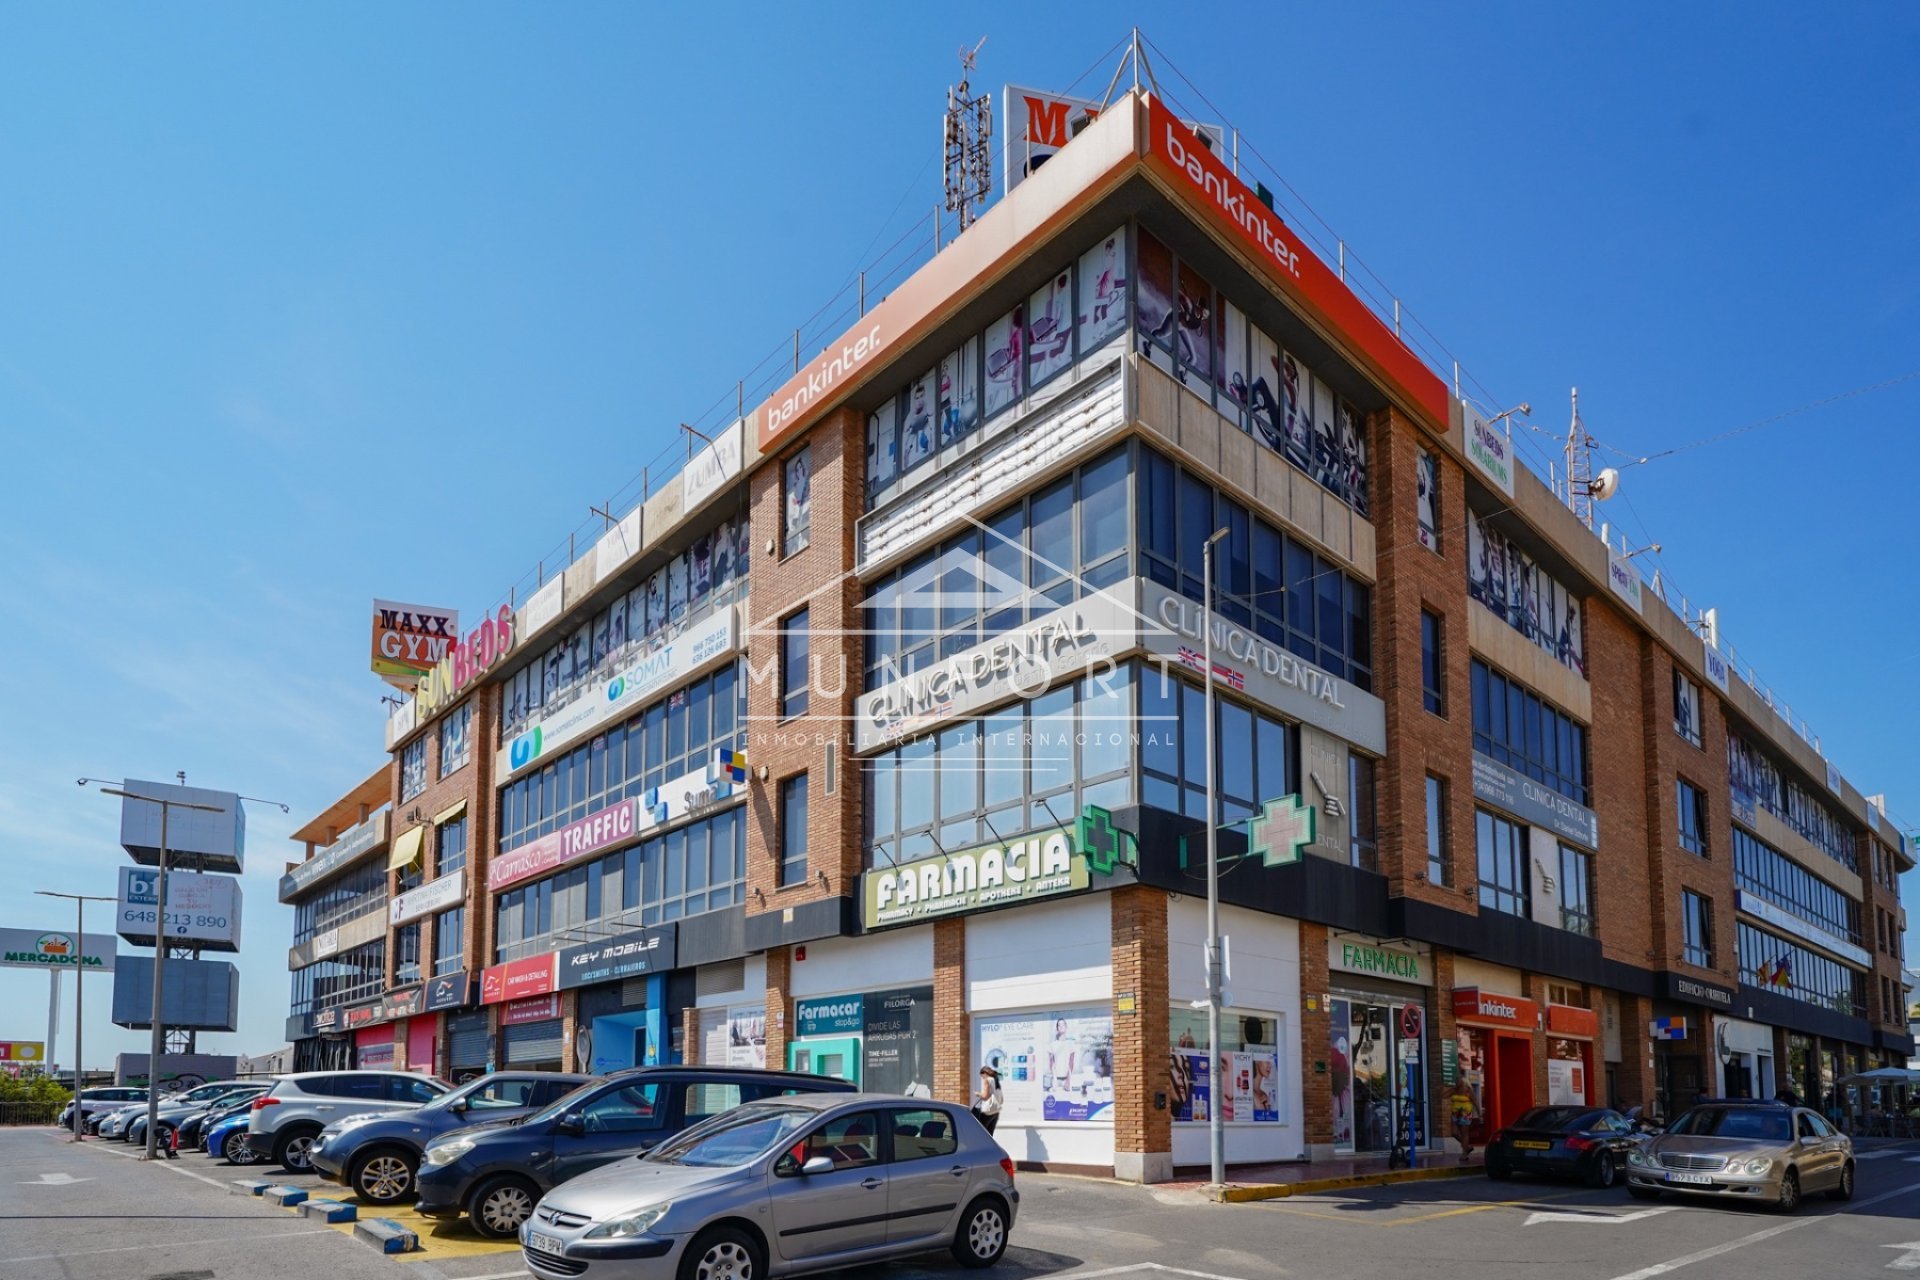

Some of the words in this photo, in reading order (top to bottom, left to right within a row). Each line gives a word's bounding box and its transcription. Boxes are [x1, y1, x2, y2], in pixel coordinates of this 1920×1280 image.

[1474, 420, 1504, 460] SUNBEDS
[686, 445, 736, 496] ZUMBA
[379, 608, 450, 636] MAXX
[380, 631, 450, 663] GYM
[416, 604, 513, 718] SUNBEDS
[971, 610, 1093, 680] DENTAL
[626, 646, 673, 690] SOMAT
[1262, 643, 1345, 709] DENTAL
[1708, 652, 1725, 685] YOGA
[1557, 799, 1588, 827] DENTAL
[563, 805, 631, 856] TRAFFIC
[1317, 833, 1345, 853] ENTAL
[877, 833, 1071, 910] FARMACIA
[124, 910, 157, 924] 648
[163, 912, 192, 925] 213
[195, 914, 227, 929] 890
[877, 906, 915, 923] PHARMACY
[924, 896, 968, 914] PHARMACIE
[571, 951, 600, 967] KEY
[1343, 943, 1419, 979] FARMACIA
[1679, 980, 1705, 998] EDIFICIO
[798, 1001, 860, 1021] Farmacar
[867, 1021, 888, 1032] DIVIDE
[889, 1020, 901, 1030] LAS
[868, 1049, 898, 1057] TIME-FILLER
